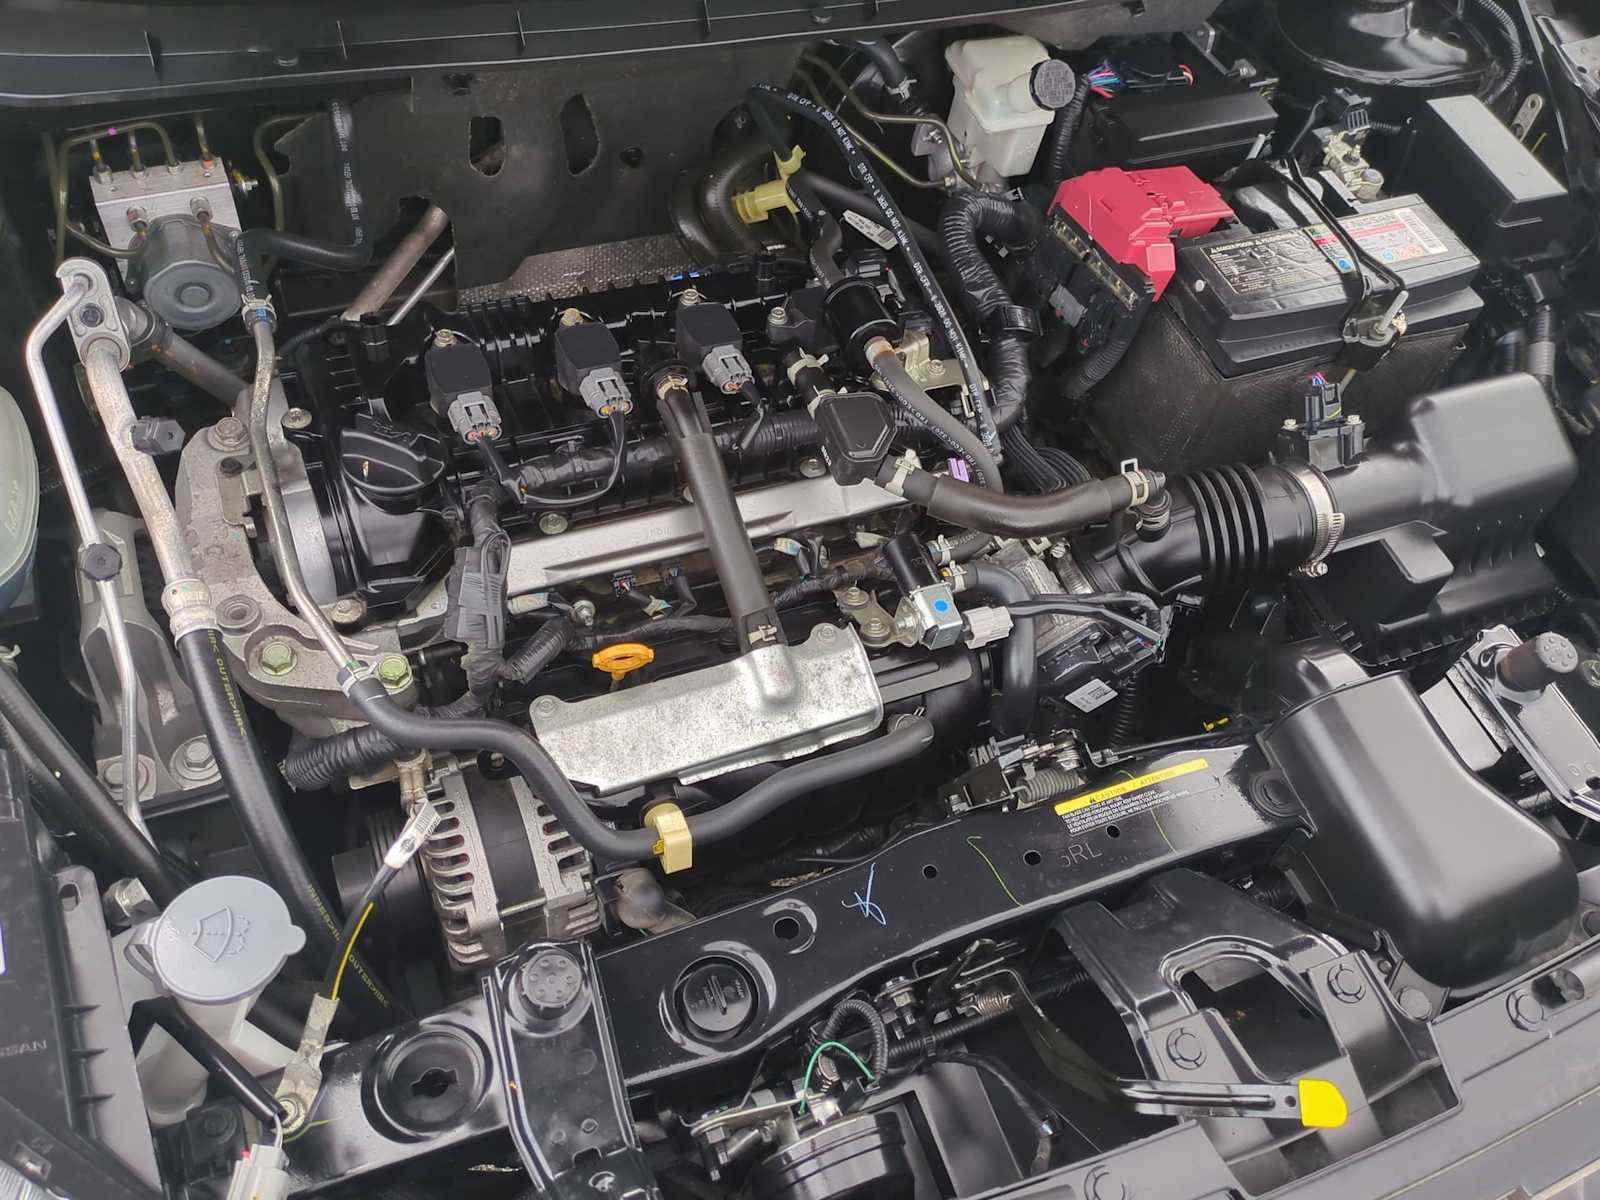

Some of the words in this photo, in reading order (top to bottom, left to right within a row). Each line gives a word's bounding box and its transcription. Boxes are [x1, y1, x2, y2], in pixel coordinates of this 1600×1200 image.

[889, 216, 901, 229] NOT
[895, 228, 909, 246] KINK
[946, 327, 959, 342] NOT
[953, 342, 968, 360] KINK
[1094, 786, 1126, 800] CAUTION
[1140, 769, 1175, 785] ATTENTION
